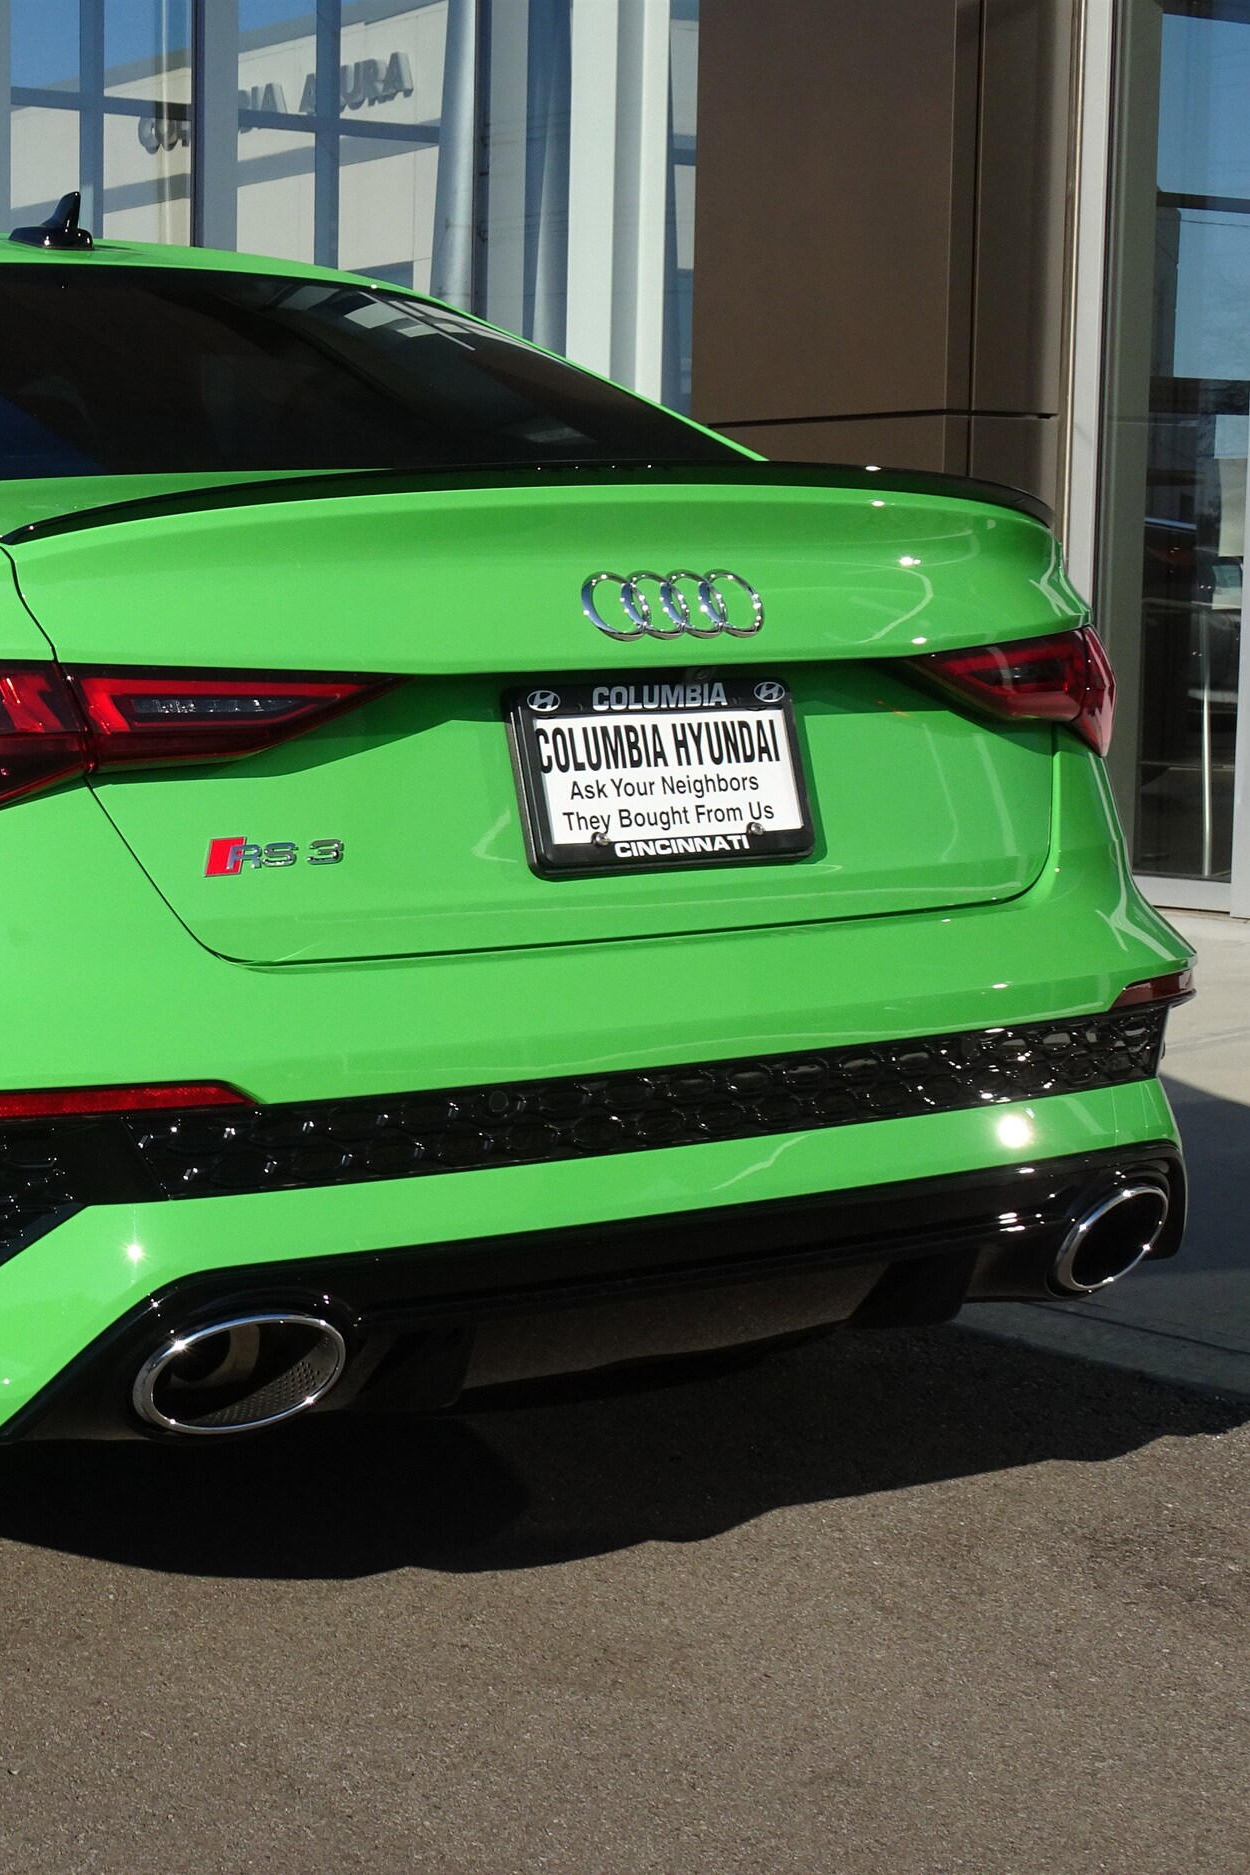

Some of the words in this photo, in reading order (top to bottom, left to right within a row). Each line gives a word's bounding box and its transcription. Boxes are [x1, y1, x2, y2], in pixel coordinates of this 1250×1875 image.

[298, 51, 414, 116] AURA
[592, 682, 728, 711] COLUMBIA
[535, 724, 668, 774] COLUMBIA
[671, 718, 781, 767] HYUNDAI
[570, 779, 607, 800] Ask
[611, 777, 655, 798] Your
[661, 773, 760, 799] Neighbors
[563, 811, 611, 835] They
[619, 806, 690, 831] Bought
[696, 803, 744, 825] From
[748, 801, 775, 821] Us
[226, 843, 298, 869] RS
[307, 839, 345, 865] 3
[614, 834, 750, 858] CINCINNATI
